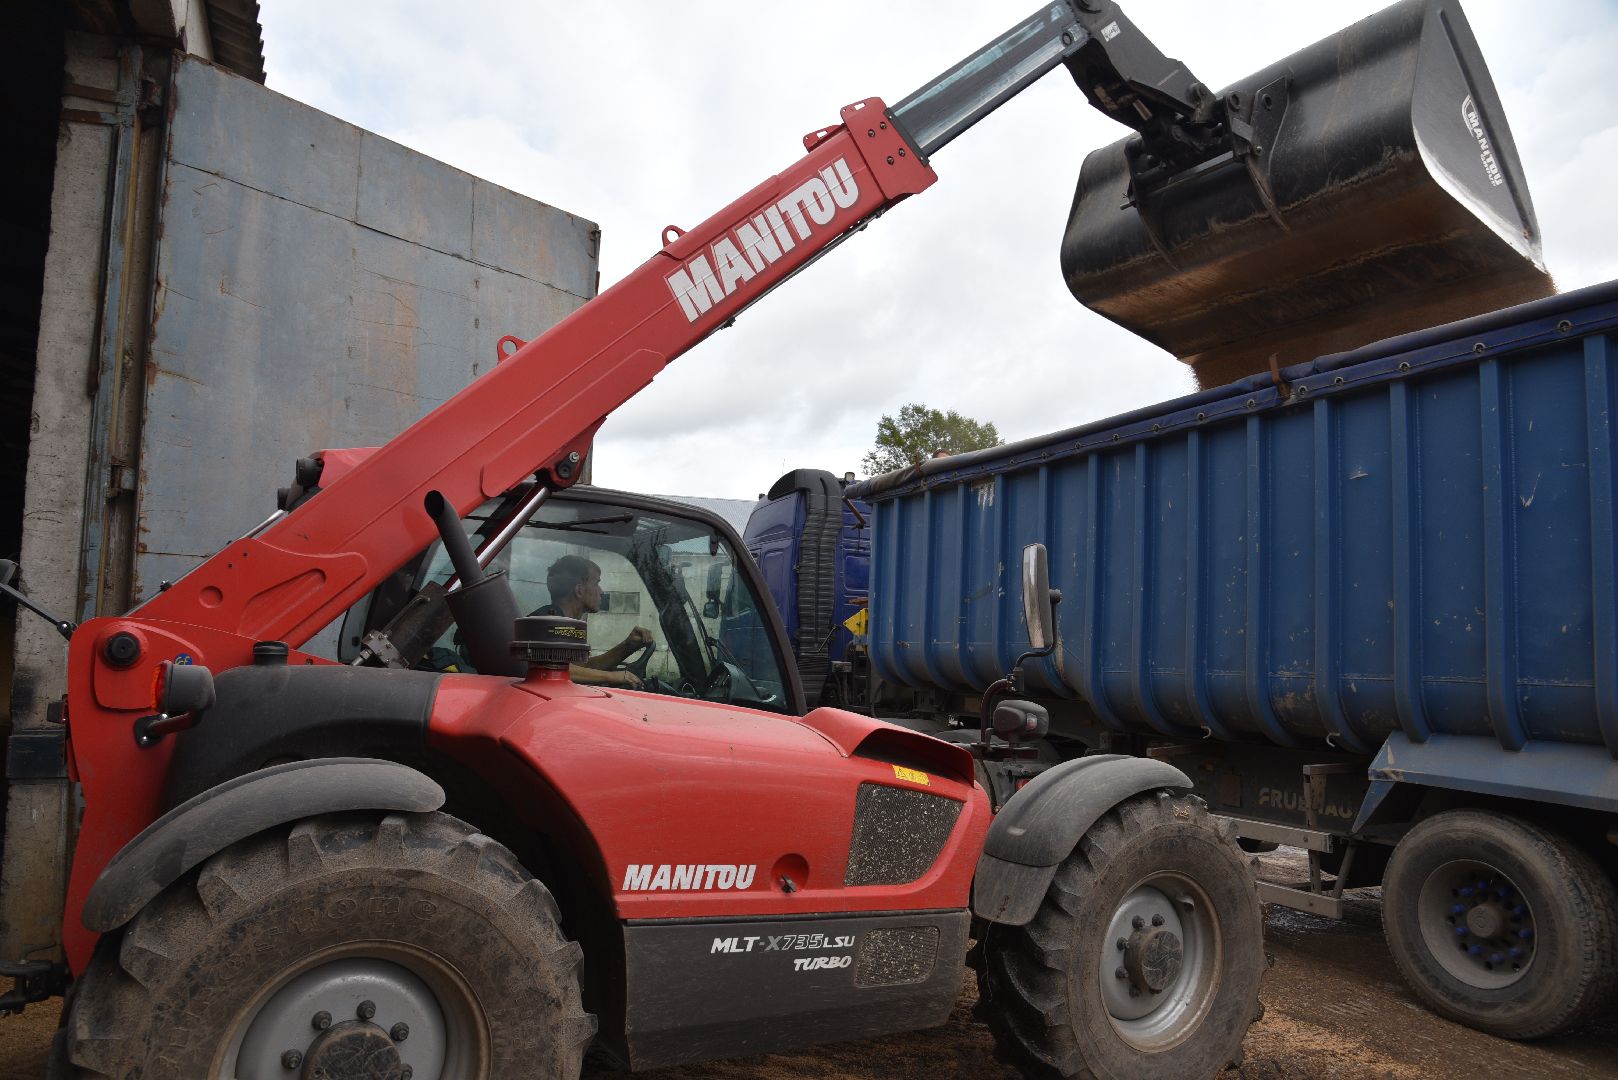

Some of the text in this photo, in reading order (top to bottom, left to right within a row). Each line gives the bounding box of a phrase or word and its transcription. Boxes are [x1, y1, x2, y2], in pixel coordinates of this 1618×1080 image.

[1468, 111, 1503, 186] MANITOU
[666, 156, 859, 323] MANITOU
[1258, 786, 1356, 819] FRUEAU
[622, 864, 756, 891] MANITOU
[793, 955, 852, 972] TURBO
